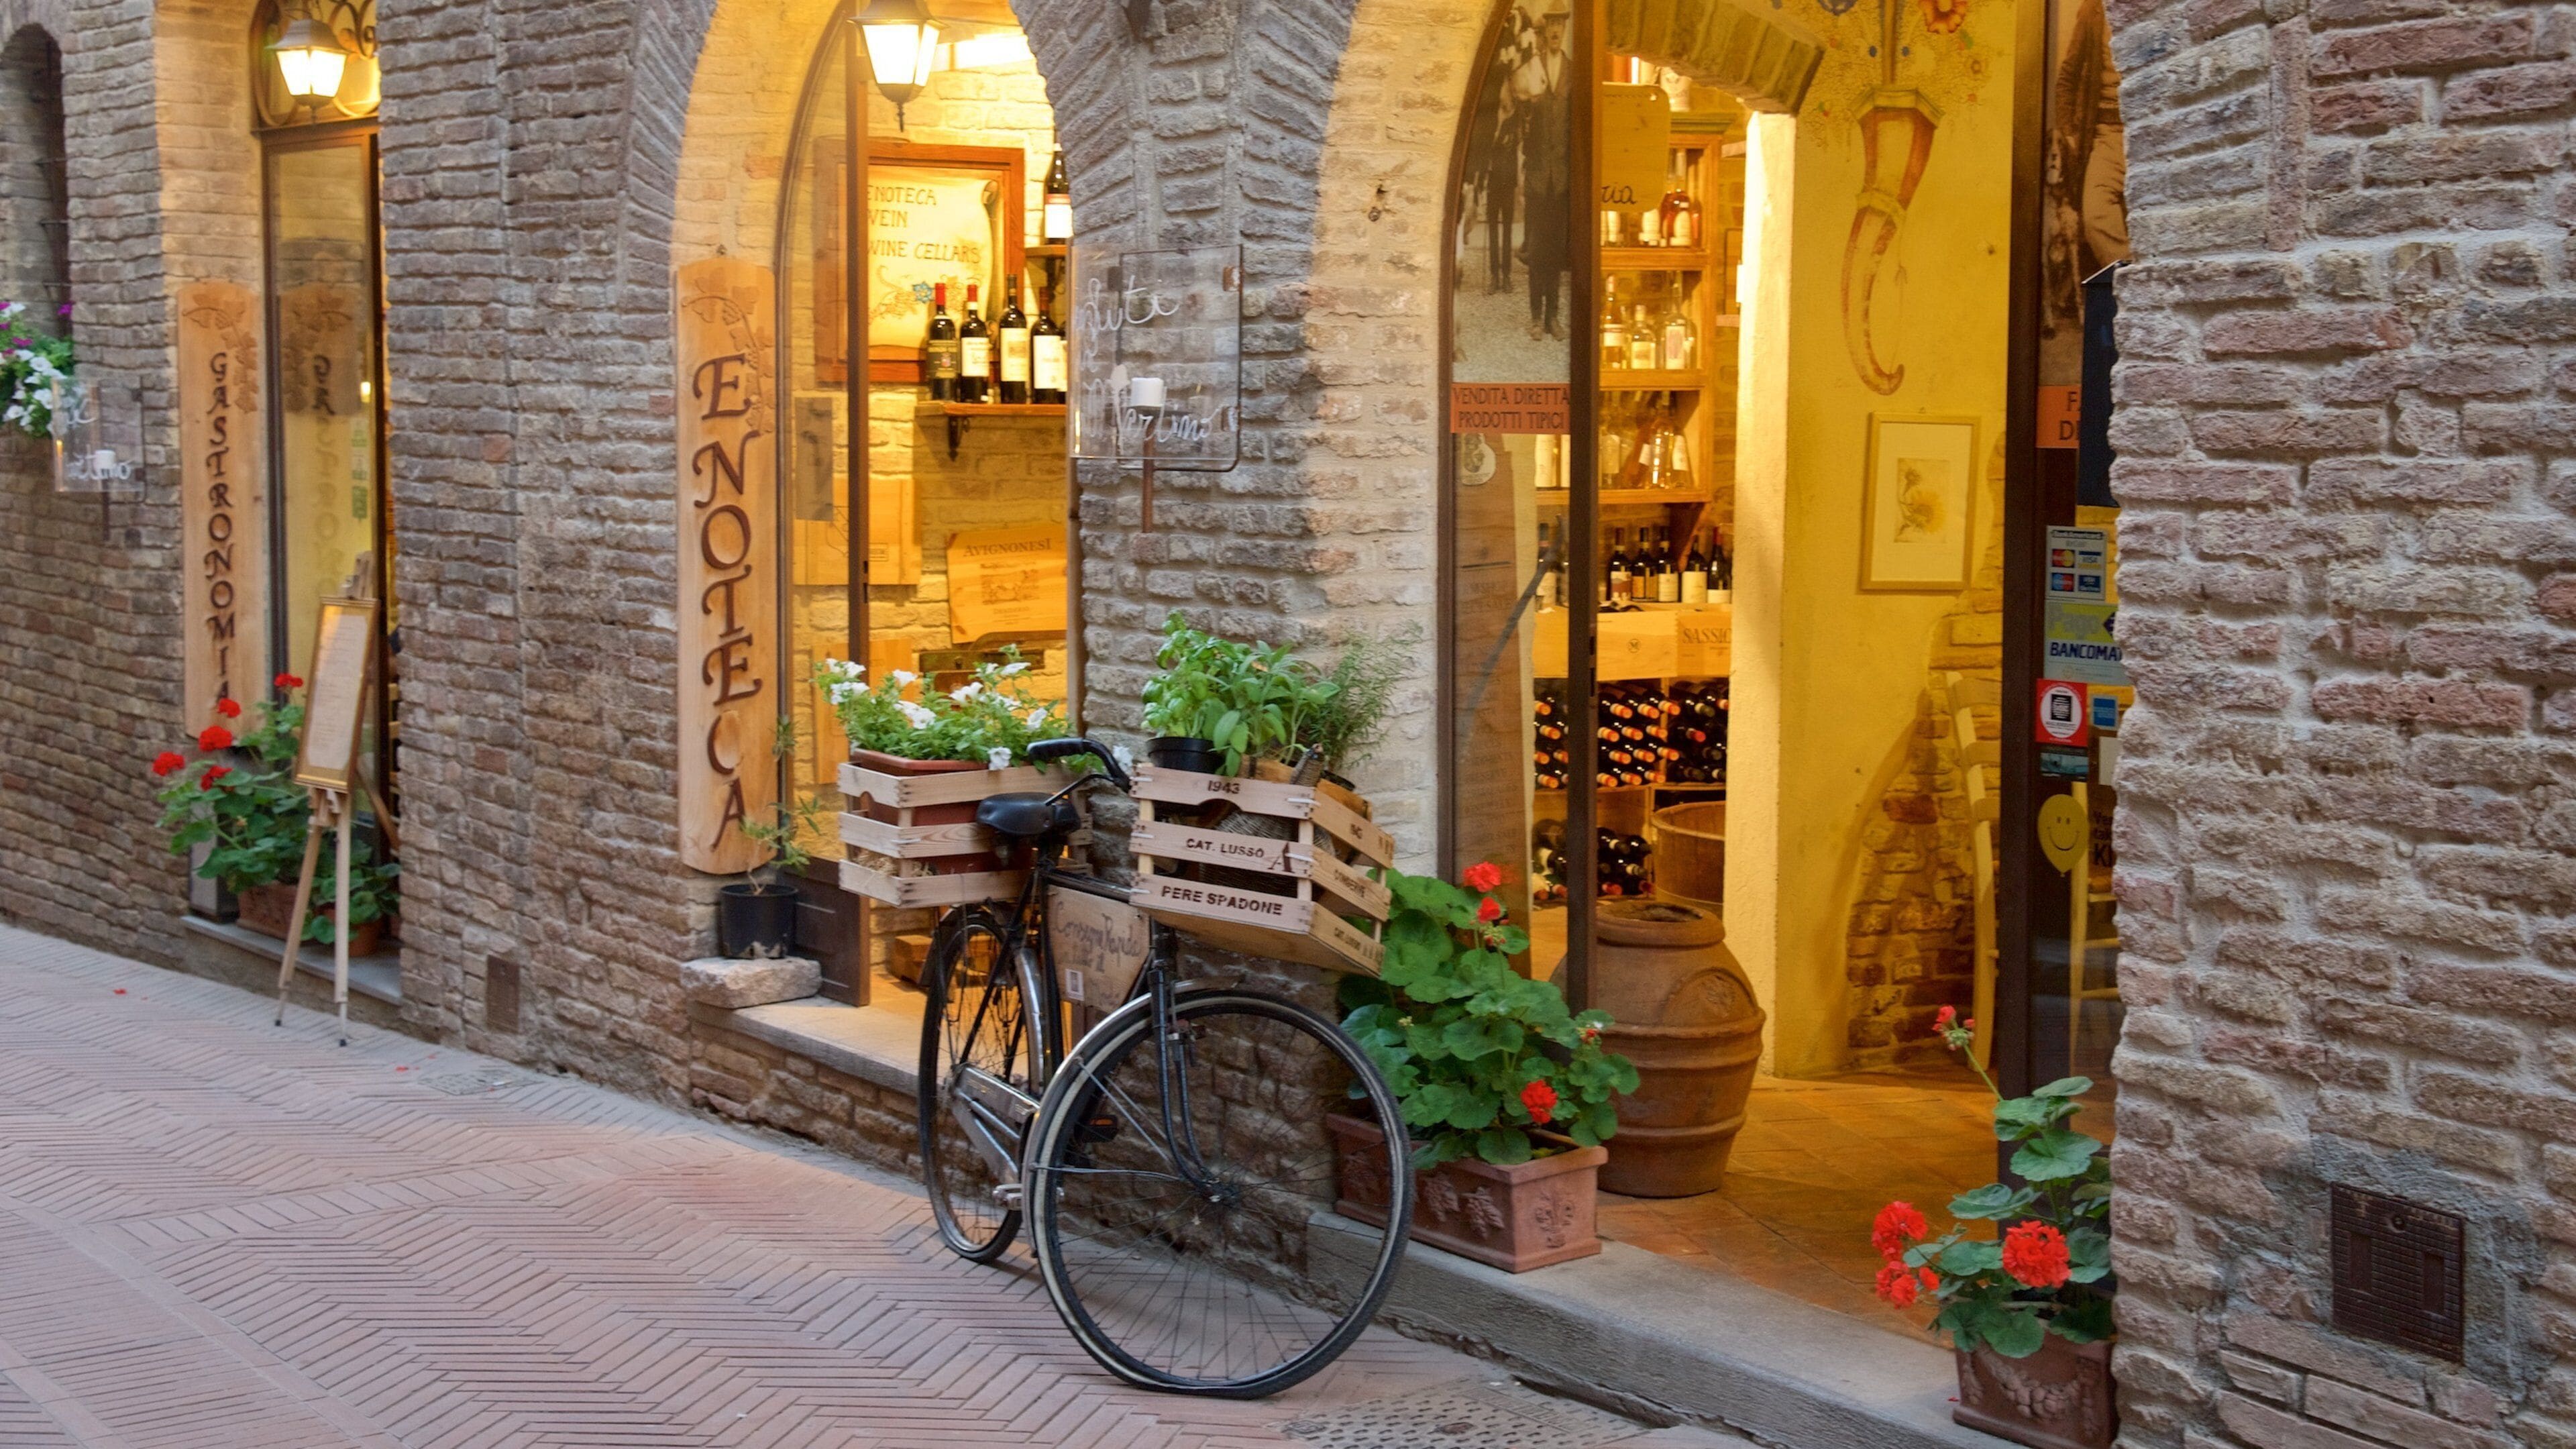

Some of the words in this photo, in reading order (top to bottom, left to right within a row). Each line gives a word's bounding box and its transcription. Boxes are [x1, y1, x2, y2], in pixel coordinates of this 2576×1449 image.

[867, 184, 937, 206] ENOTECA
[914, 242, 982, 264] CELLARS
[1454, 387, 1509, 405] VENDITA
[1513, 387, 1570, 405] DIRETTA
[1458, 411, 1522, 429] PRODOTTI
[1527, 411, 1564, 429] TIPICI
[203, 352, 236, 708] GASTRONOMIA
[963, 538, 1052, 557] AVIGNONESI
[692, 353, 763, 852] ENOTECA
[1208, 780, 1241, 794] 1943
[1185, 838, 1216, 851] CAT.
[1220, 843, 1265, 859] LUSSO
[1161, 885, 1203, 904] PERE
[1207, 892, 1284, 916] SPADONE
